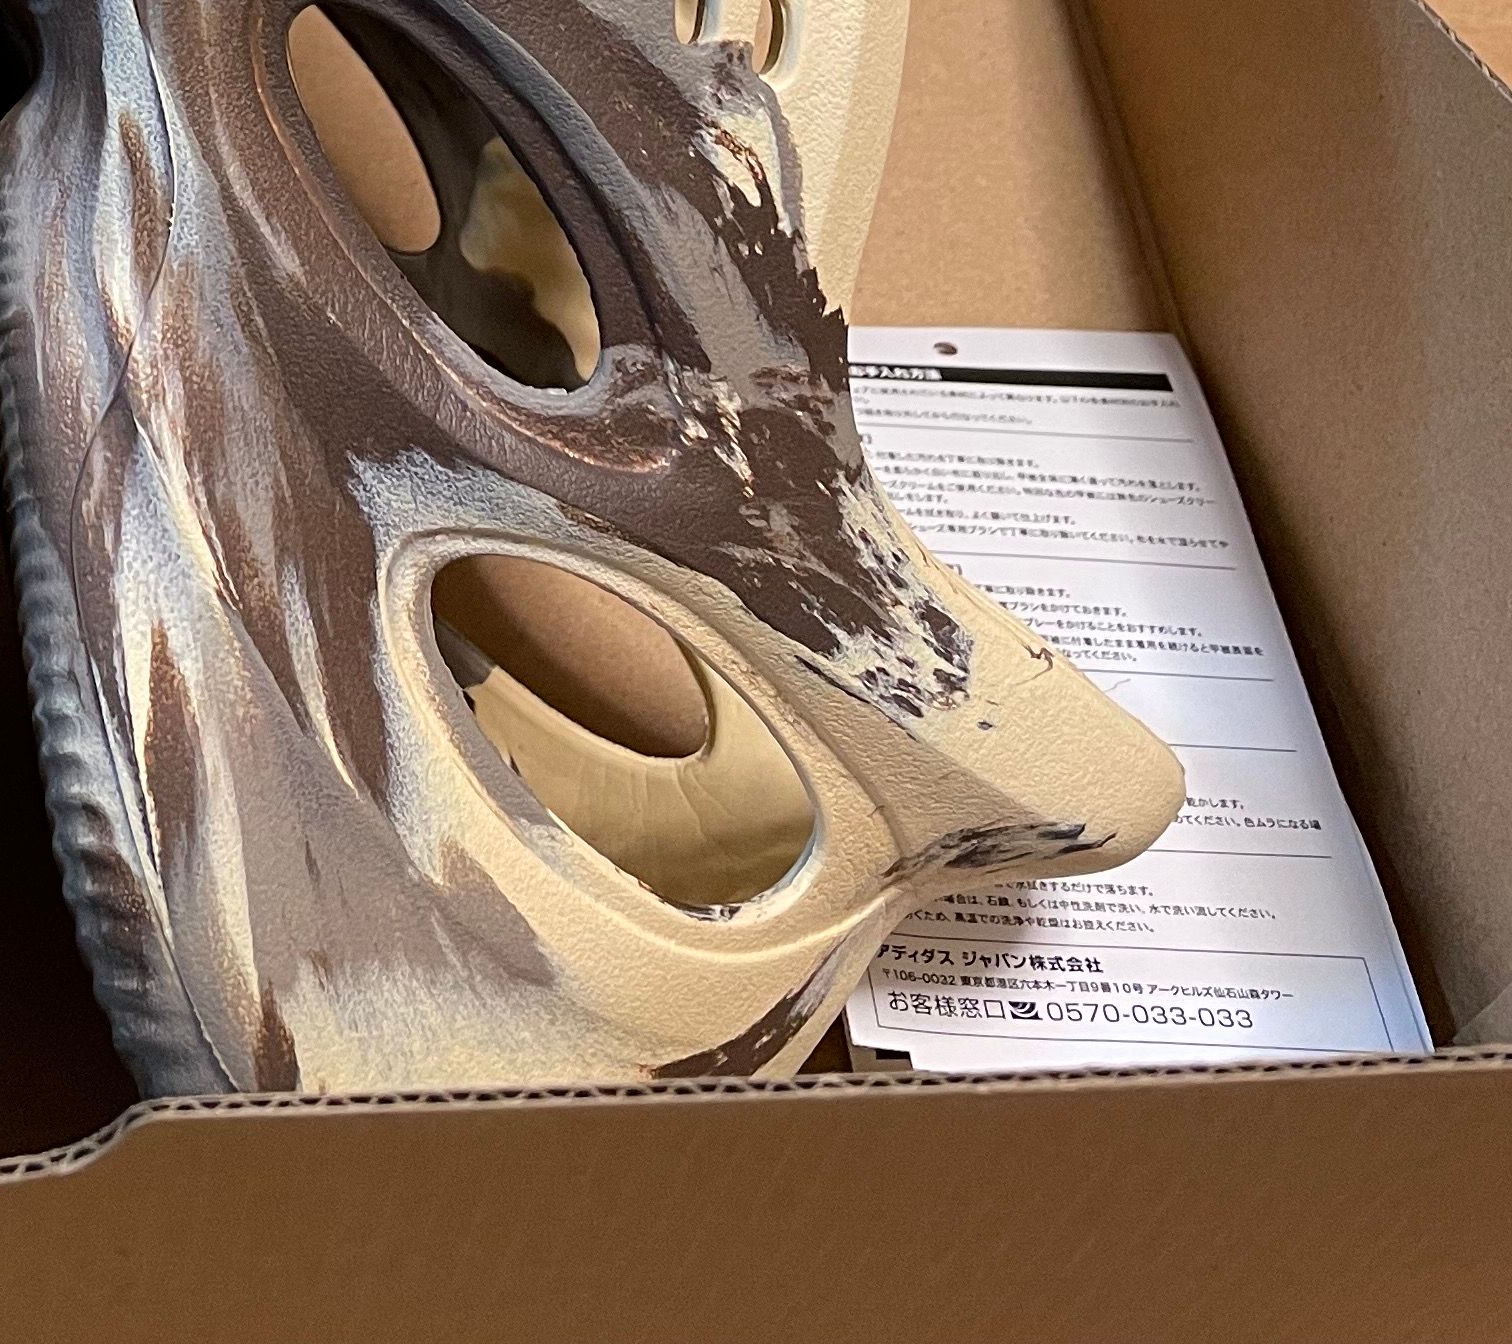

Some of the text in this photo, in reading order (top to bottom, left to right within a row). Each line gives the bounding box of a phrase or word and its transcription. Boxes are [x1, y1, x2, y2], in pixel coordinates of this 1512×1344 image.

[961, 951, 1104, 974] ジャパン株式会社
[887, 989, 1255, 1030] お客様窓口 0570-033-033
